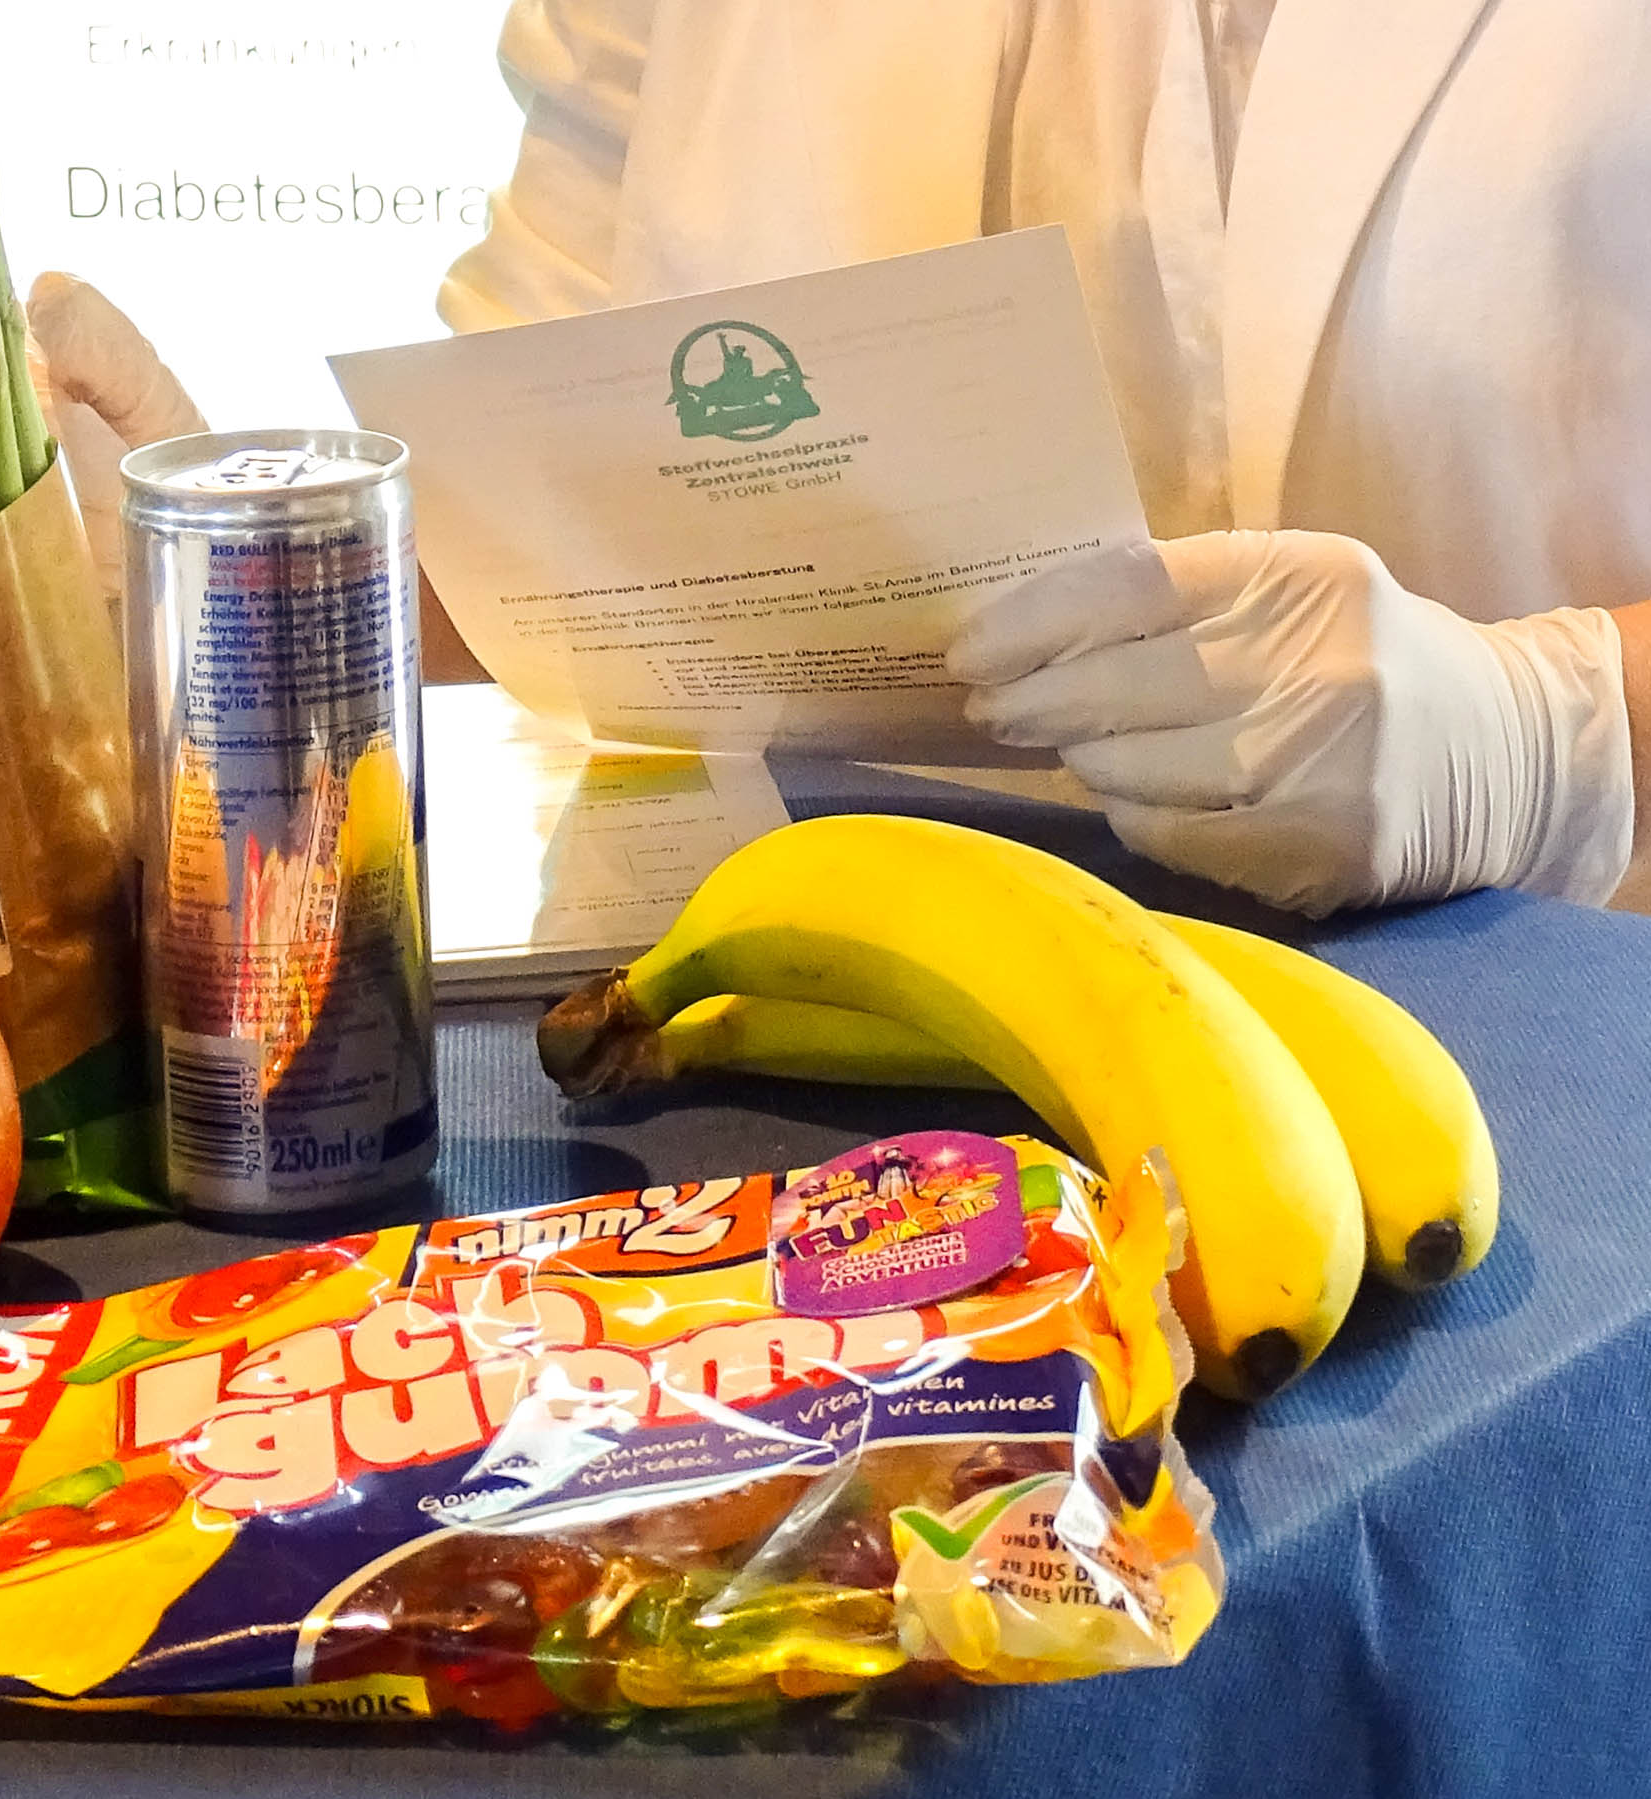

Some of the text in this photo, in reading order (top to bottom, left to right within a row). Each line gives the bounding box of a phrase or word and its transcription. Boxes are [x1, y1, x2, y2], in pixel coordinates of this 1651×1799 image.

[658, 434, 869, 477] Stoffwechselpraxis
[686, 453, 853, 490] Zentralschweiz
[785, 471, 842, 490] GmbH
[211, 545, 235, 556] RED
[238, 544, 269, 556] BULL
[499, 563, 816, 605] Ernährungstherapie und Diabetesberatung
[600, 605, 685, 622] Standorten
[688, 604, 703, 613] in
[706, 601, 729, 611] der
[817, 584, 859, 599] Klinik
[926, 570, 945, 581] im
[949, 555, 1011, 577] Bahnhof
[1016, 545, 1068, 563] Luzern
[1073, 538, 1102, 551] und
[823, 595, 887, 613] folgende
[890, 571, 1015, 602] Dienstleistungen
[367, 620, 385, 633] Nur
[794, 643, 888, 660] Übergewicht
[790, 1199, 907, 1261] FUN
[877, 1192, 1000, 1243] TASTIC
[905, 1242, 966, 1263] YOUR
[820, 1253, 967, 1294] ADVENTURE
[887, 1392, 1056, 1417] vitamines
[1001, 1533, 1040, 1550] UND
[1029, 1558, 1067, 1582] JUS
[1021, 1586, 1051, 1604] DES
